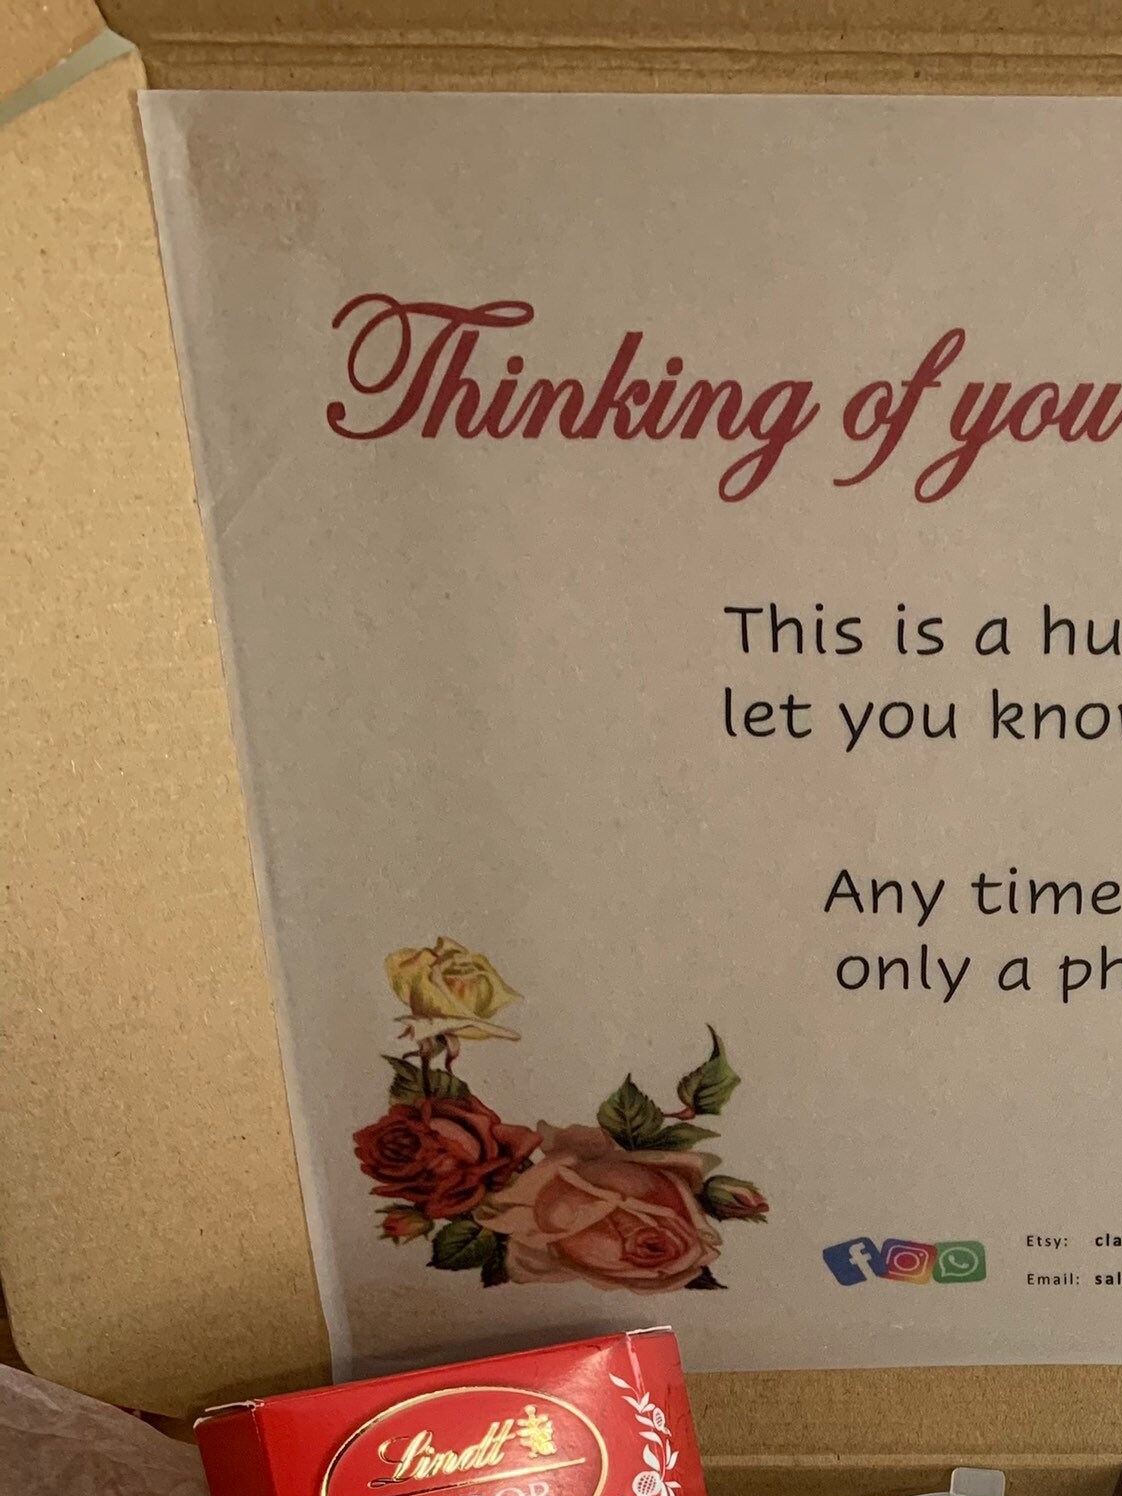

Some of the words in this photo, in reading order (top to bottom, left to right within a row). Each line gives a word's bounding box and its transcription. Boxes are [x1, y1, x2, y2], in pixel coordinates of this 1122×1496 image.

[326, 293, 822, 503] Thinking
[833, 327, 965, 487] of
[723, 602, 863, 655] This
[897, 603, 944, 656] is
[975, 617, 1011, 656] a
[724, 686, 812, 739] let
[838, 701, 957, 753] you
[823, 869, 945, 928] Any
[970, 866, 1122, 915] time
[836, 943, 971, 1004] only
[998, 956, 1032, 992] a
[1026, 1235, 1068, 1250] Etsy:
[1027, 1272, 1080, 1286] Email:
[367, 1418, 517, 1489] Lindt
